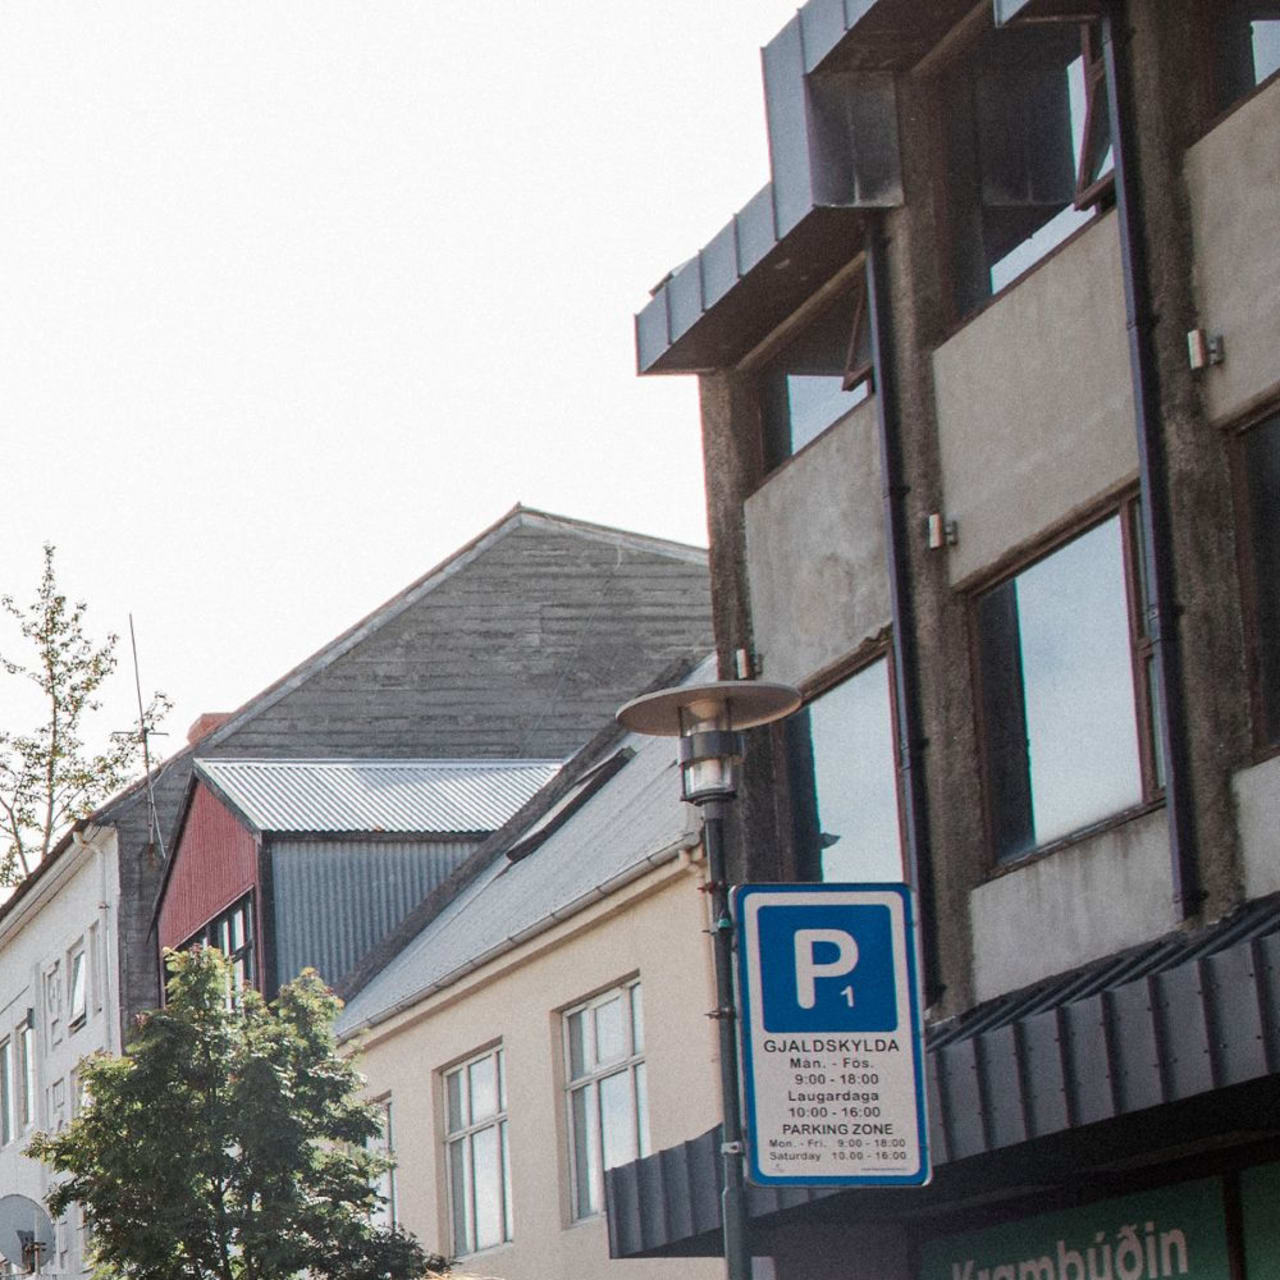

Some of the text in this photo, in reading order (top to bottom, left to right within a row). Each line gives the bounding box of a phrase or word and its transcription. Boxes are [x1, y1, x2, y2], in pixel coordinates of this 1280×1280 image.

[794, 928, 859, 1010] P
[840, 985, 855, 1008] 1
[762, 1038, 901, 1054] GJALDSKYLDA
[794, 1073, 826, 1085] 9:00
[840, 1073, 880, 1085] 18:00
[788, 1090, 880, 1105] Laugardaga
[788, 1106, 828, 1118] 10:00
[841, 1106, 881, 1118] 16:00
[782, 1123, 894, 1135] PARKING ZONE
[769, 1151, 822, 1162] Saturday
